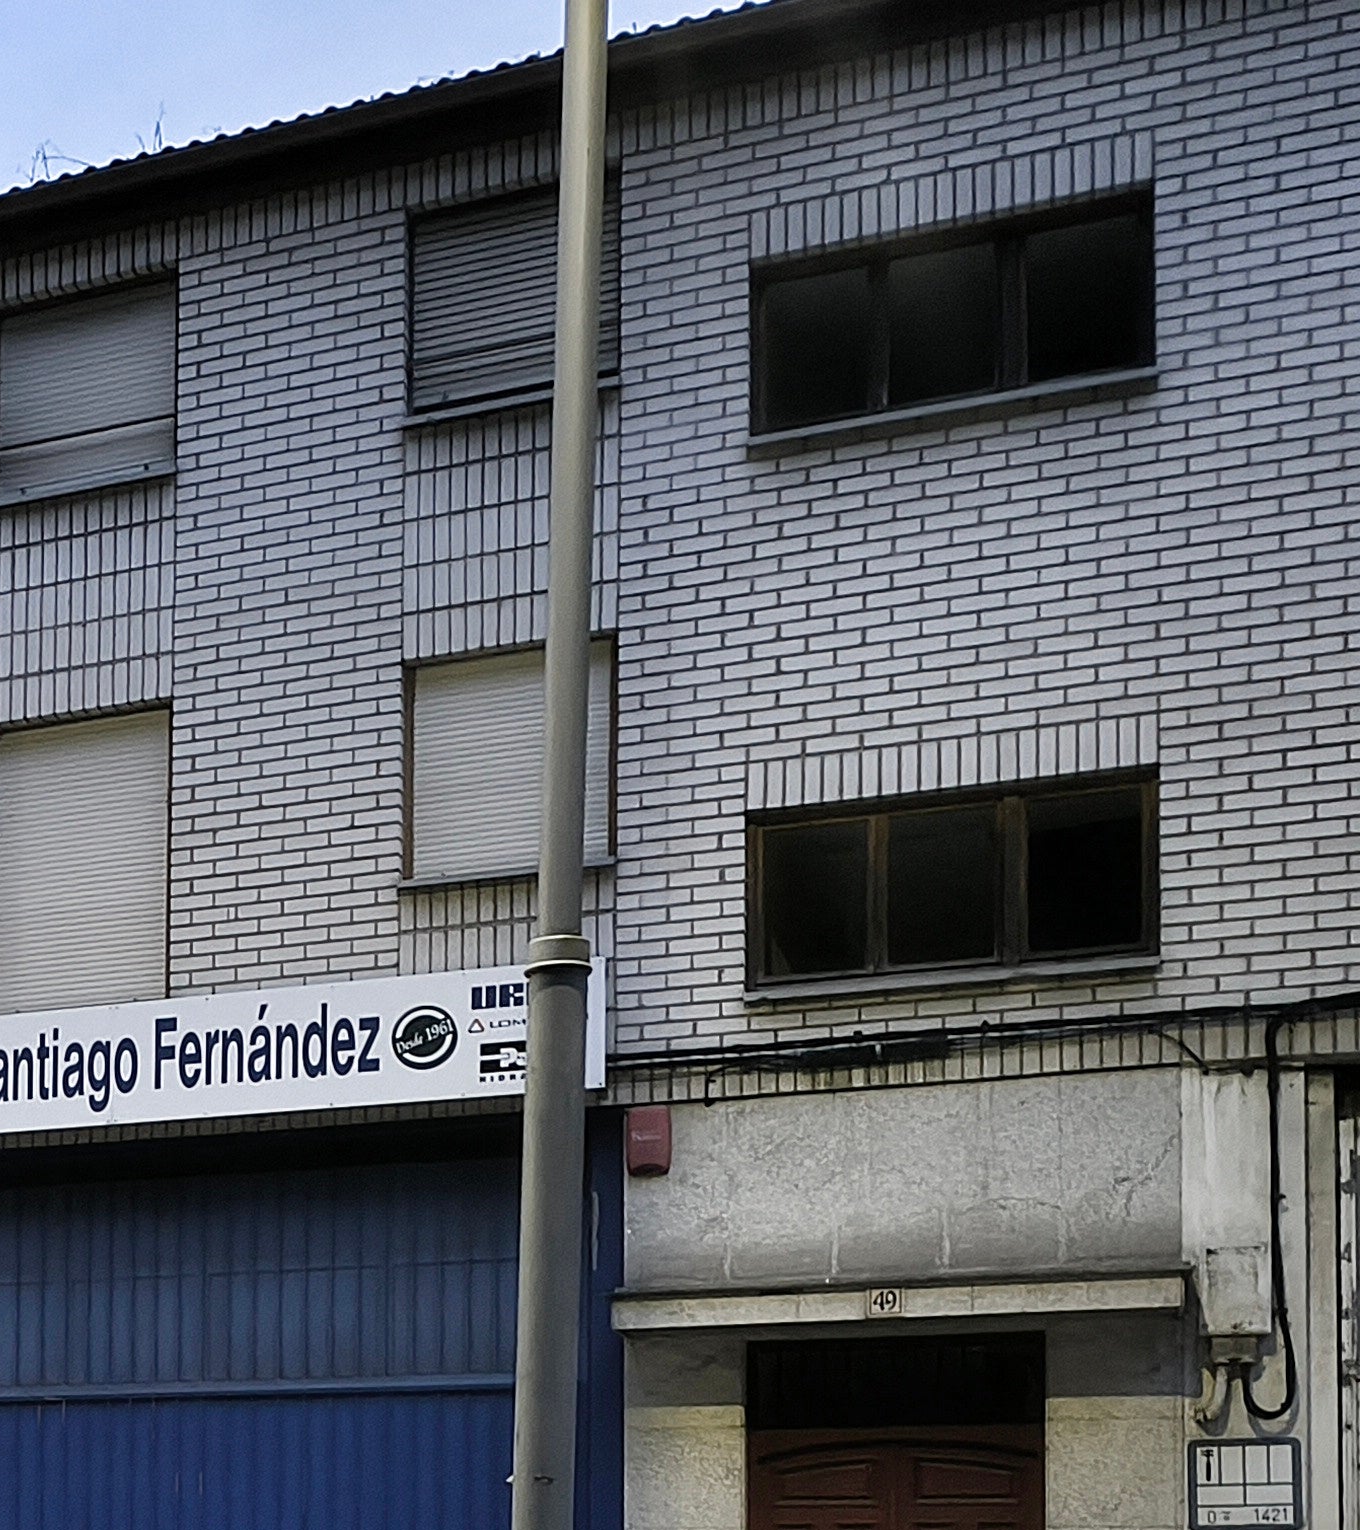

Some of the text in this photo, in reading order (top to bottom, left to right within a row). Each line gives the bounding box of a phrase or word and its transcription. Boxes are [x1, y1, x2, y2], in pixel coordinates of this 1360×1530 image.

[489, 1018, 527, 1029] LOM
[395, 1018, 455, 1054] Desde 1961
[154, 1003, 380, 1090] Fernández
[479, 1072, 527, 1083] HIDRA
[873, 1290, 897, 1311] 49
[1254, 1507, 1288, 1522] 1421
